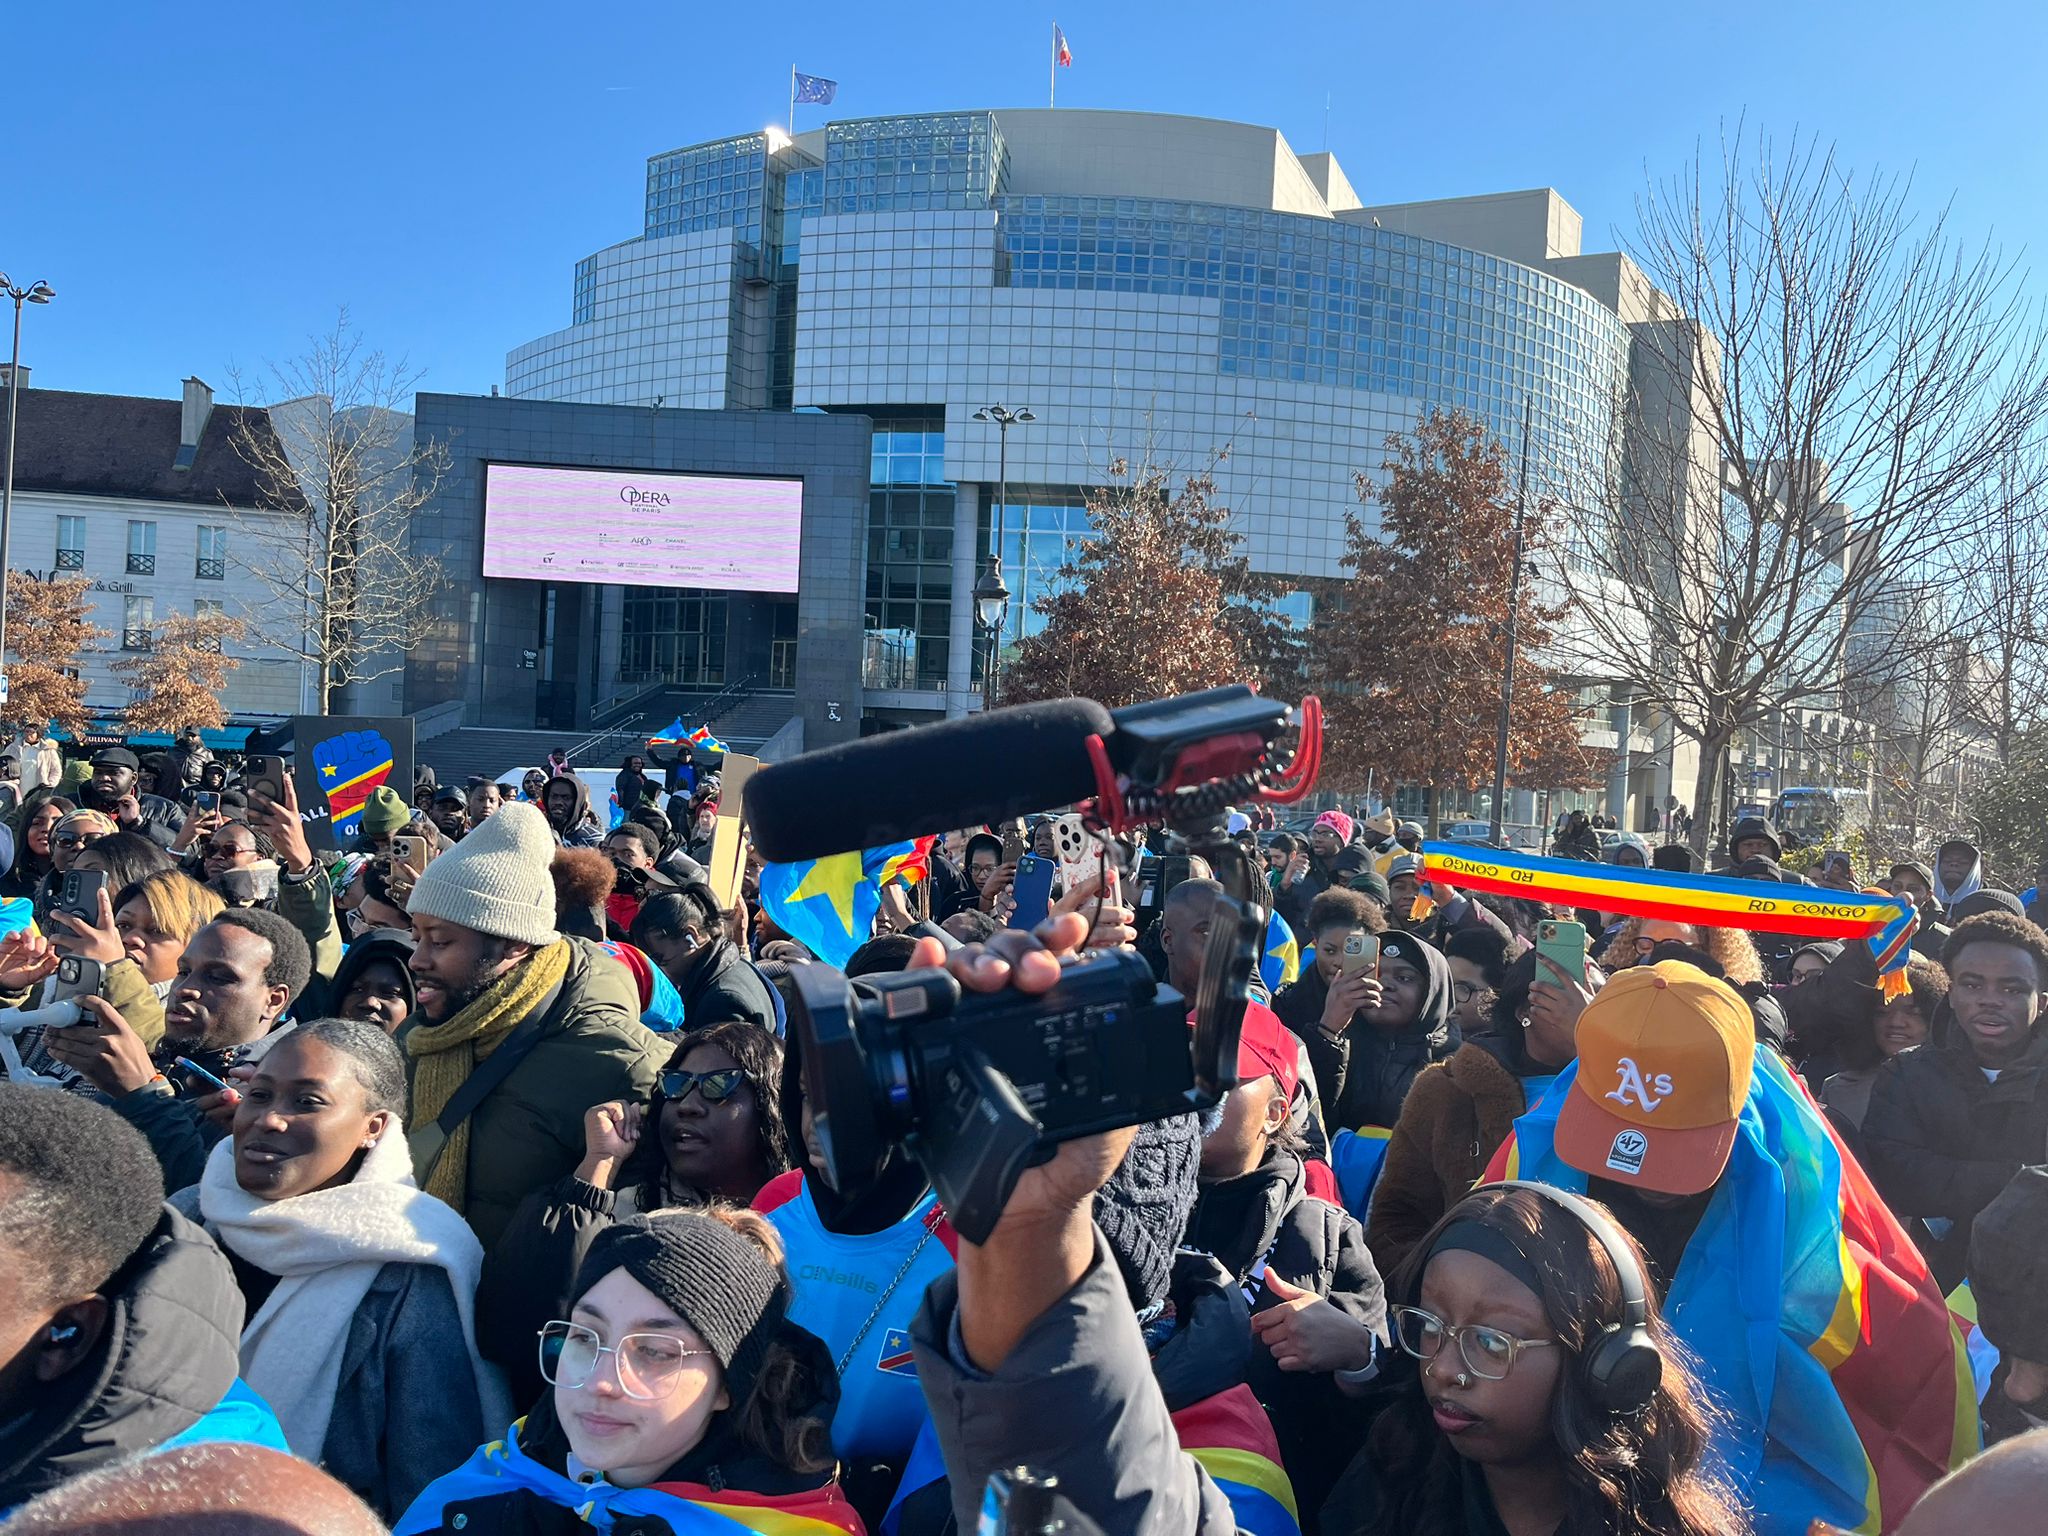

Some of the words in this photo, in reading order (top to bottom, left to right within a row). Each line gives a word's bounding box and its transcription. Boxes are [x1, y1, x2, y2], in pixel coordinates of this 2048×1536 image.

[95, 581, 105, 592] &
[108, 581, 134, 593] Grill
[1442, 857, 1499, 877] CONGO
[1510, 869, 1535, 883] RD
[1748, 899, 1777, 912] RD
[1792, 903, 1867, 918] CONGO
[1604, 1057, 1674, 1113] A's
